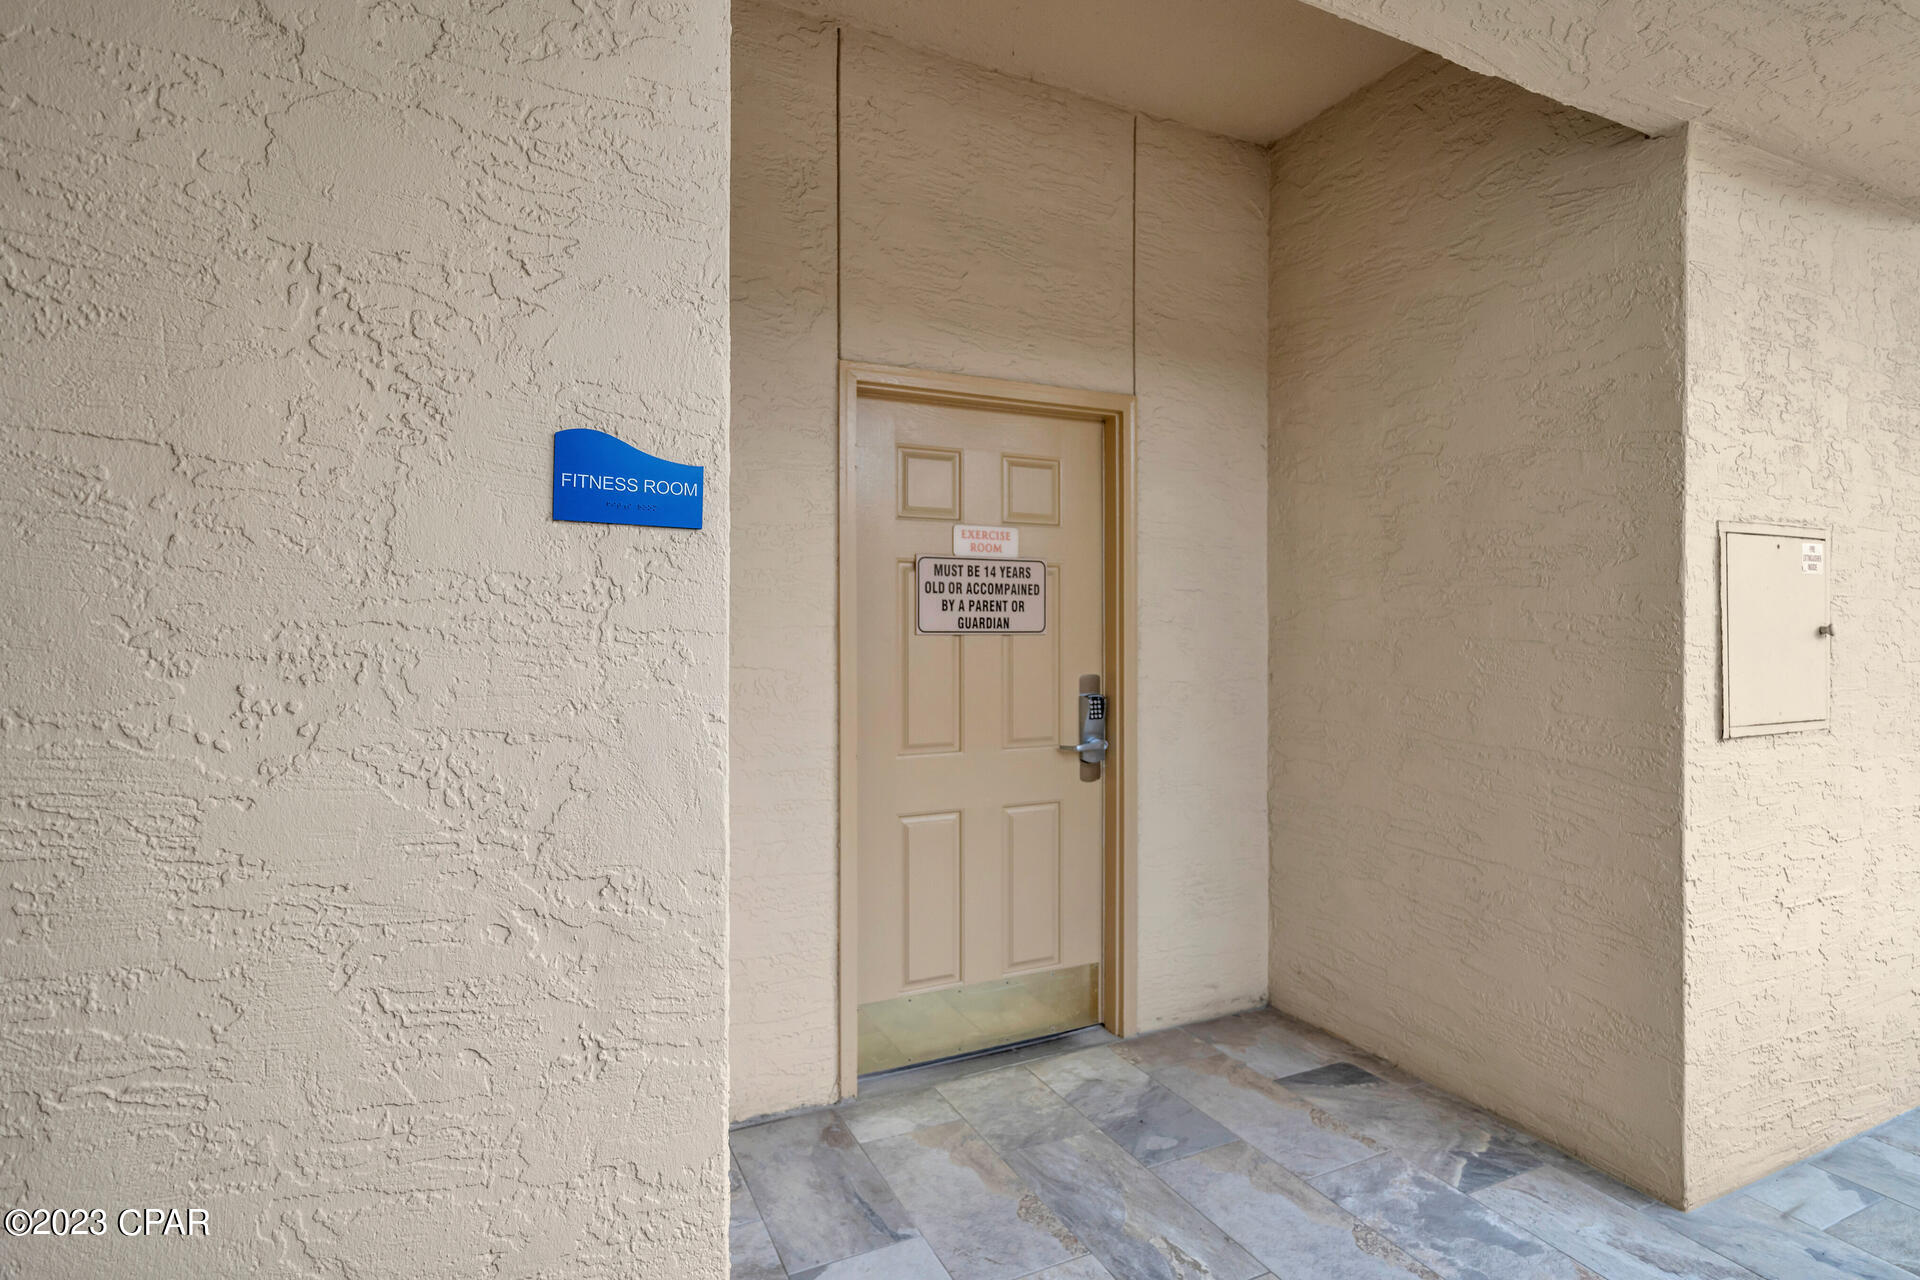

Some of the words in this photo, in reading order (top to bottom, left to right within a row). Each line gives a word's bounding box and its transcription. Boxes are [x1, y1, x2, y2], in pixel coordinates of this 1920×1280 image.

[561, 472, 638, 493] FITNESS
[643, 479, 698, 497] ROOM
[961, 529, 1012, 541] EXERCISE
[970, 542, 1003, 553] ROOM
[934, 564, 963, 577] MUST
[967, 565, 980, 578] BE
[984, 566, 996, 578] 14
[1000, 566, 1031, 579] YEARS
[924, 581, 945, 594] OLD
[948, 582, 963, 595] OR
[966, 583, 1040, 596] ACCOMPAINED
[941, 599, 955, 612] BY
[958, 600, 965, 612] A
[968, 600, 1008, 612] PARENT
[1011, 601, 1025, 612] OR
[957, 617, 1010, 630] GUARDIAN
